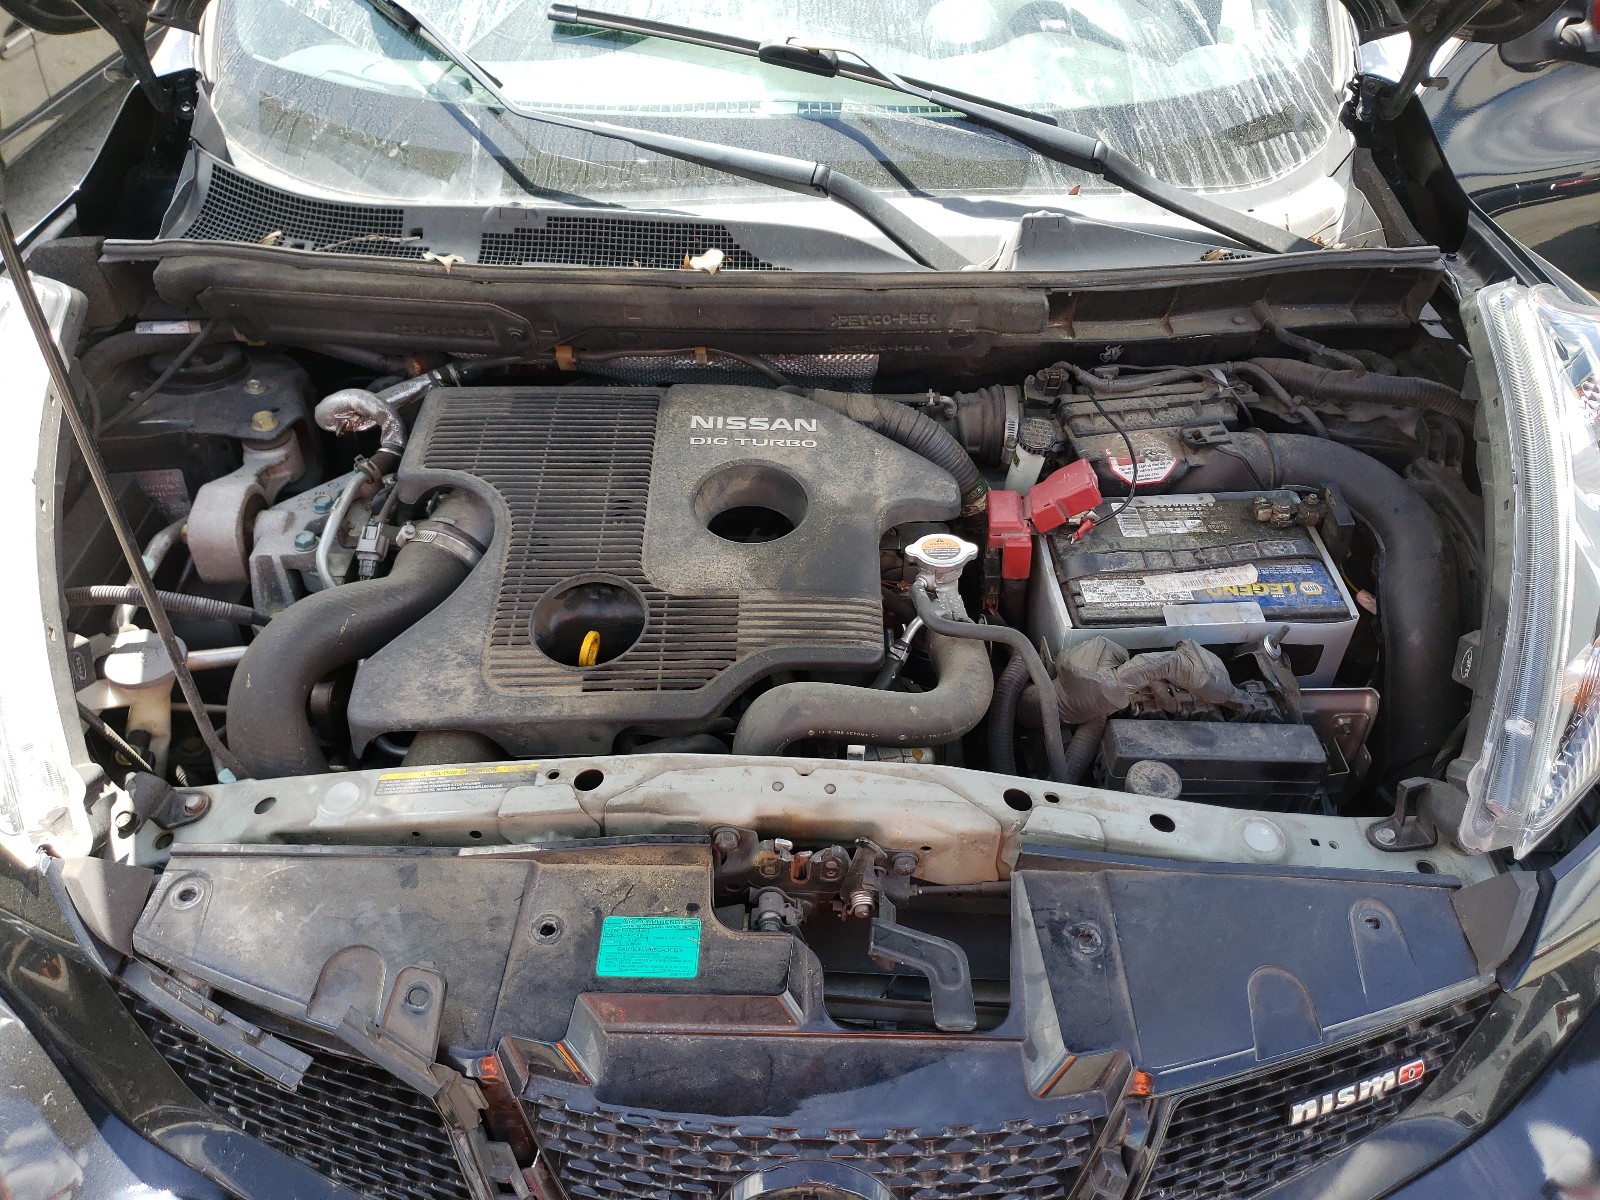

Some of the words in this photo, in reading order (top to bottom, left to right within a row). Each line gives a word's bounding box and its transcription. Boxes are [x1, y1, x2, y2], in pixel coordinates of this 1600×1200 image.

[690, 415, 817, 432] NISSAN
[690, 437, 728, 446] DIG
[735, 438, 818, 448] TURBO
[1290, 1058, 1425, 1126] nismo
